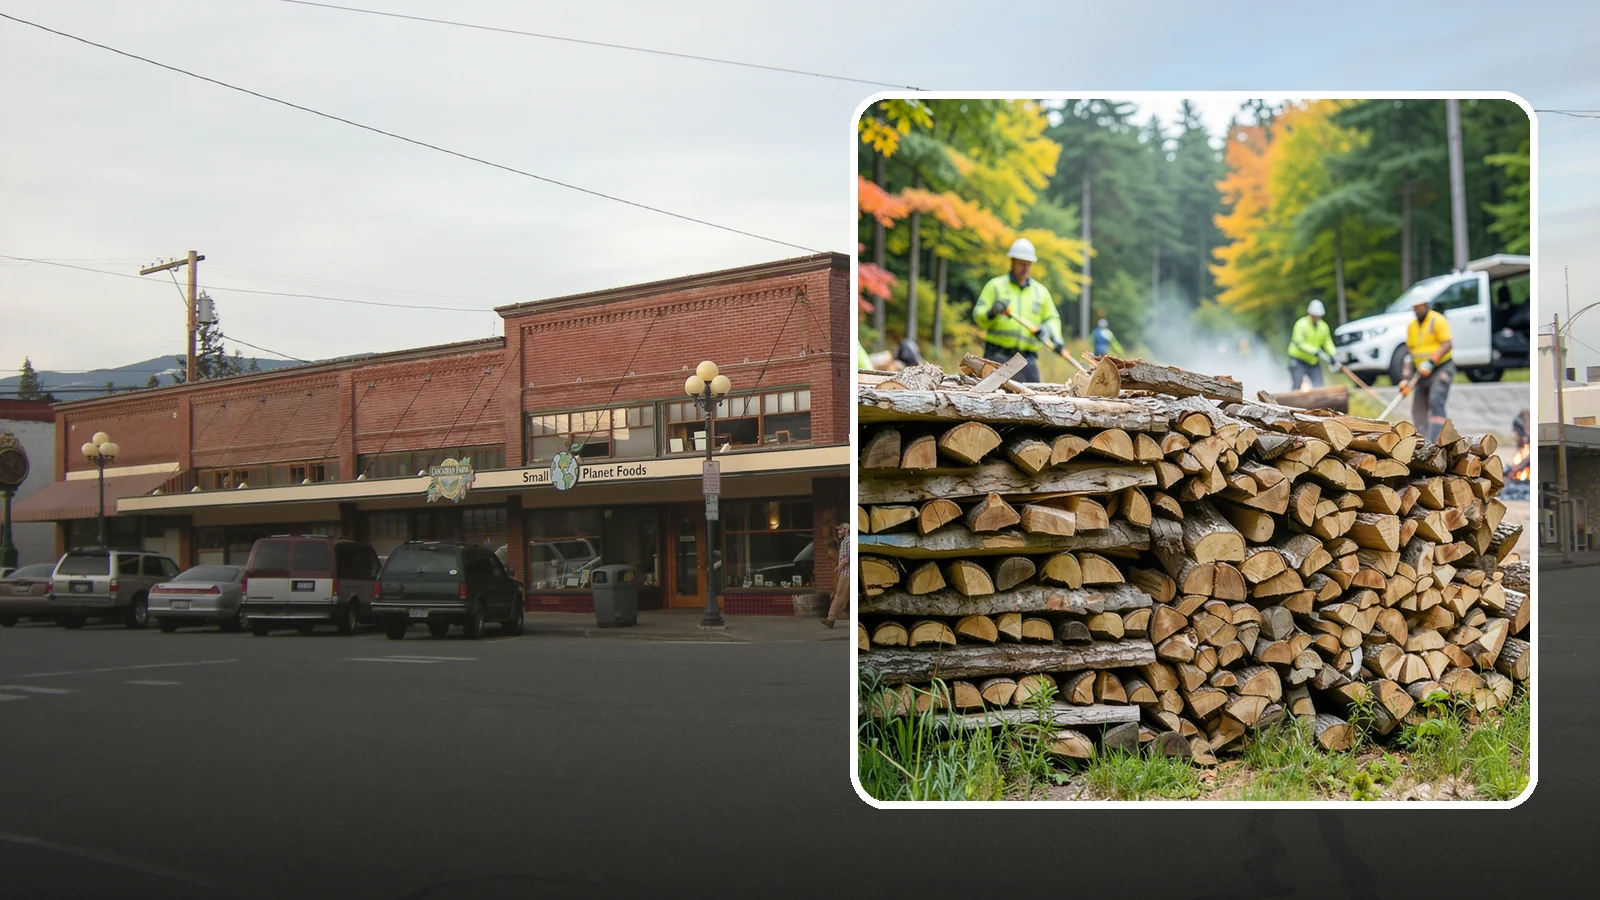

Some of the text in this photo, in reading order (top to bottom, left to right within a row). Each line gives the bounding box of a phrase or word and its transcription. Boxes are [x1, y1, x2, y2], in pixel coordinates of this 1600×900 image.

[523, 464, 647, 483] Small Planet Foods
